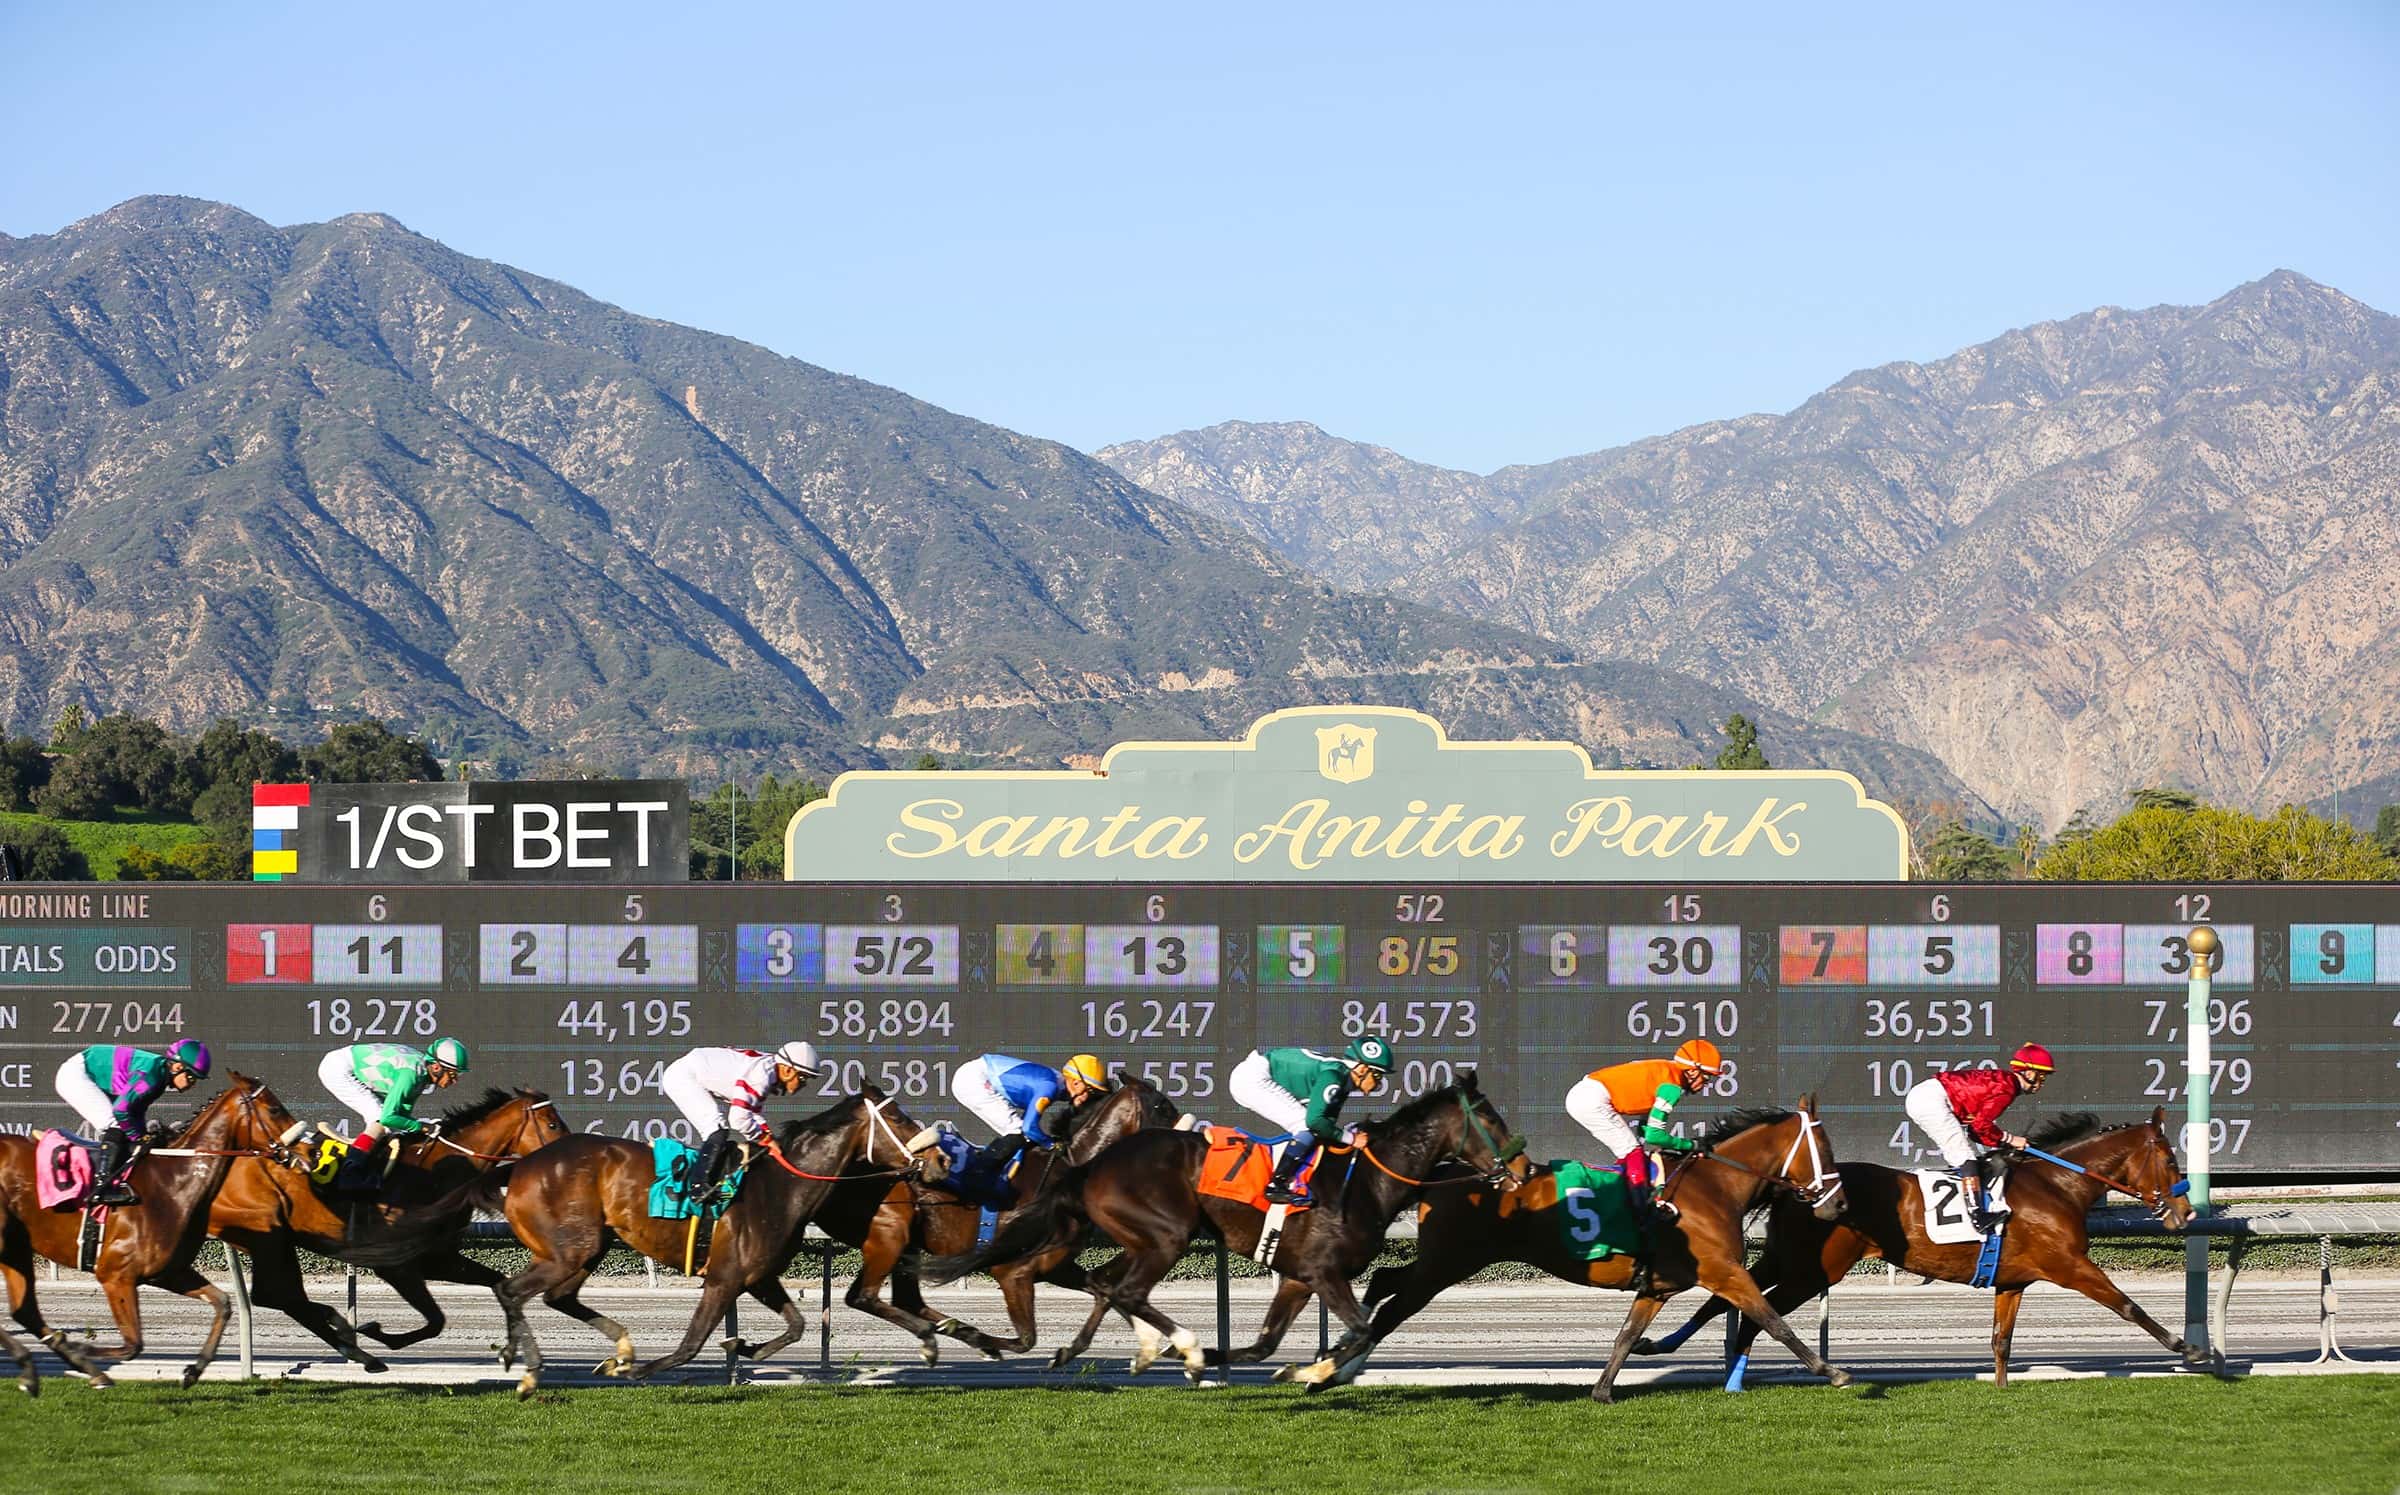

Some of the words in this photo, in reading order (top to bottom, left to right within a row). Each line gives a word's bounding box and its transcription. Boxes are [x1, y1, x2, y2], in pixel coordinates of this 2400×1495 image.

[336, 804, 495, 870] 1/ST
[512, 801, 669, 869] BET
[887, 798, 1209, 860] Santa
[1234, 798, 1525, 870] Anita
[103, 895, 151, 919] LINE
[369, 895, 388, 921] 6
[624, 895, 644, 922] 5
[885, 895, 904, 922] 3
[1147, 895, 1166, 922] 6
[1396, 895, 1445, 923] 5/2
[1665, 895, 1702, 922] 15
[1931, 895, 1951, 922] 6
[2176, 894, 2212, 922] 12
[0, 946, 65, 973] TALS
[95, 946, 177, 973] ODDS
[259, 930, 277, 976] 1
[347, 937, 403, 975] 11
[511, 931, 537, 976] 2
[618, 937, 651, 975] 4
[766, 929, 794, 977] 3
[854, 937, 935, 976] 5/2
[1026, 931, 1056, 977] 4
[1123, 937, 1187, 976] 13
[1288, 931, 1316, 977] 5
[1378, 937, 1459, 977] 8/5
[1550, 932, 1578, 978] 6
[1647, 937, 1714, 976] 30
[1811, 932, 1835, 977] 7
[1924, 937, 1956, 976] 5
[2068, 931, 2094, 976] 8
[2320, 930, 2345, 976] 9
[52, 1001, 186, 1037] 277,044
[307, 999, 437, 1041] 18,278
[557, 1000, 692, 1042] 44,195
[817, 1000, 955, 1043] 58,894
[1081, 1001, 1216, 1043] 16,247
[1341, 1001, 1478, 1043] 84,573
[1627, 1000, 1739, 1043] 6,510
[1865, 1000, 1994, 1043] 36,531
[2143, 998, 2252, 1041] 7,96
[0, 1064, 33, 1088] CE
[561, 1058, 665, 1101] 13,64
[817, 1059, 948, 1097] 20581
[311, 1138, 349, 1184] 6
[1222, 1136, 1255, 1182] 7
[1565, 1187, 1601, 1242] 5
[1932, 1179, 1964, 1226] 2
